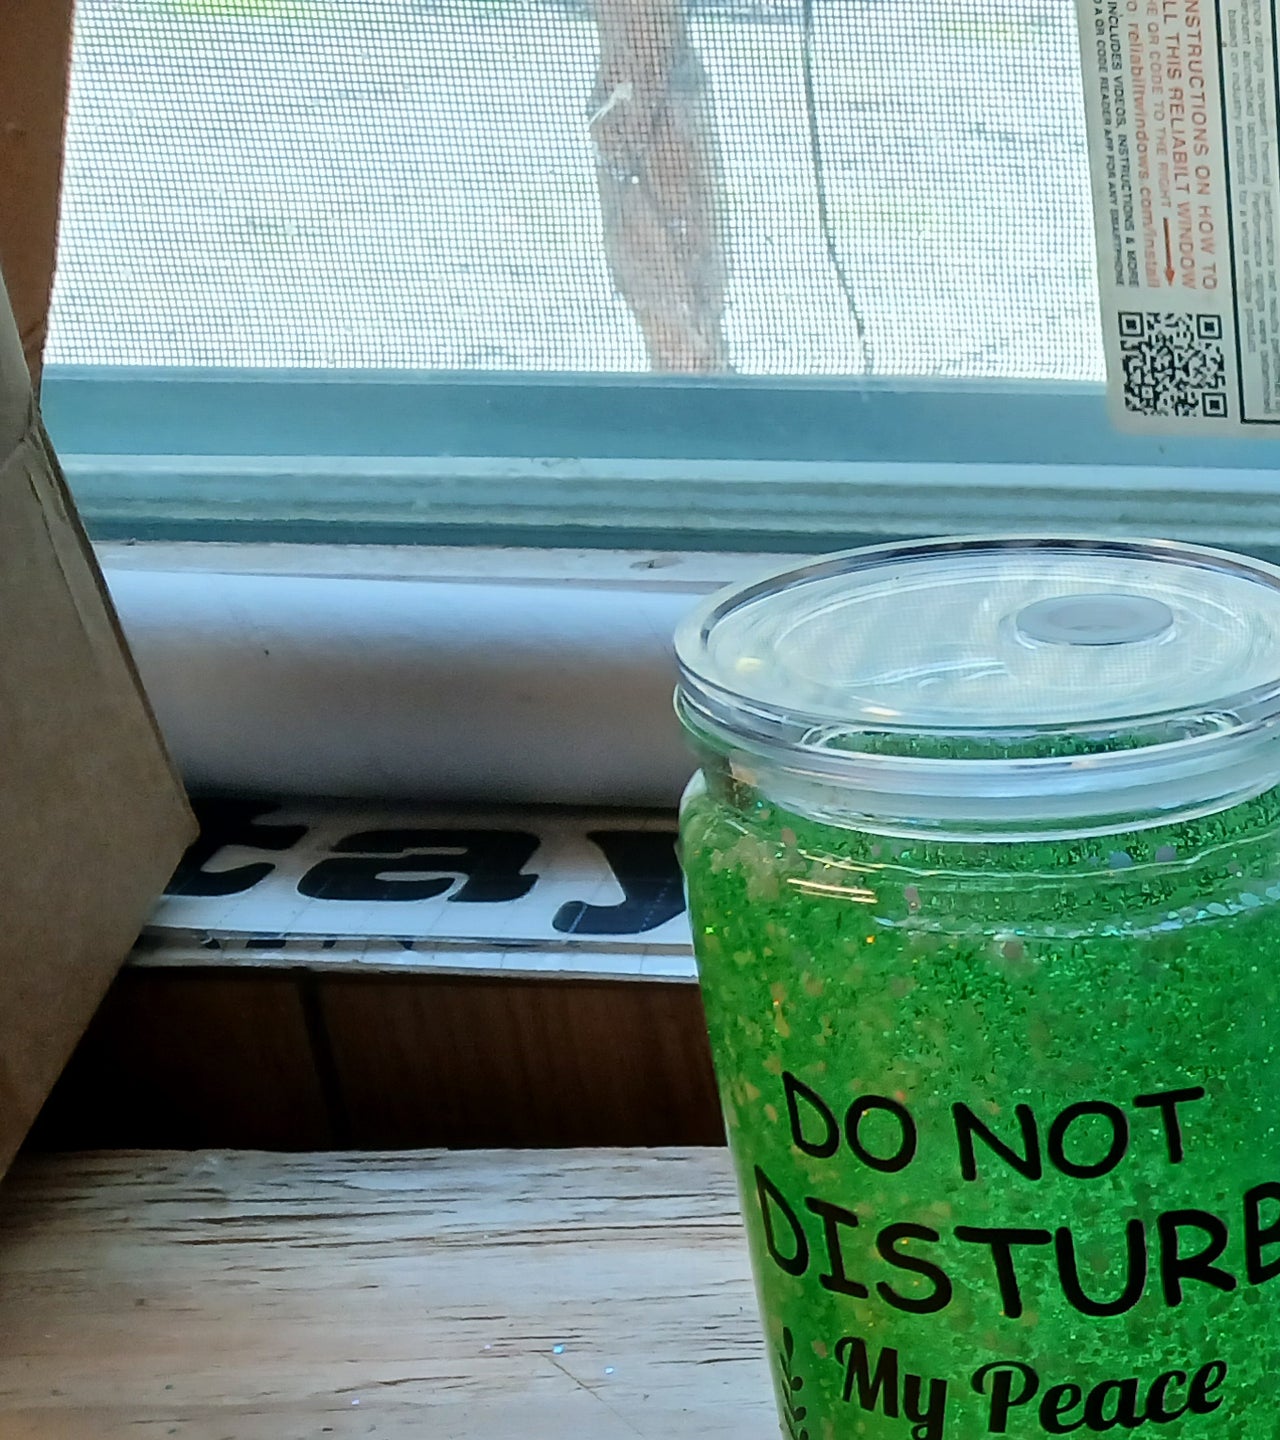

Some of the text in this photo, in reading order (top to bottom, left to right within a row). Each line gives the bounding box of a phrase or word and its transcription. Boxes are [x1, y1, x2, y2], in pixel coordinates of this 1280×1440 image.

[1146, 22, 1159, 45] QR
[1164, 33, 1181, 80] THIS
[1148, 51, 1161, 94] CODE
[1099, 77, 1112, 125] READER
[1152, 101, 1164, 121] TO
[1106, 1, 1121, 70] INCLUDES
[1117, 134, 1133, 231] INSTRUCTIONS
[1125, 251, 1138, 288] MORE
[1154, 127, 1167, 155] THE
[1167, 87, 1189, 194] RELIABILT
[1156, 162, 1170, 208] RIGHT
[1194, 165, 1209, 195] ON
[1175, 202, 1195, 289] WINDOW
[1197, 206, 1215, 254] HOW
[1201, 263, 1217, 290] TO
[782, 1070, 1204, 1181] DO NOT
[971, 1360, 1227, 1434] Peace
